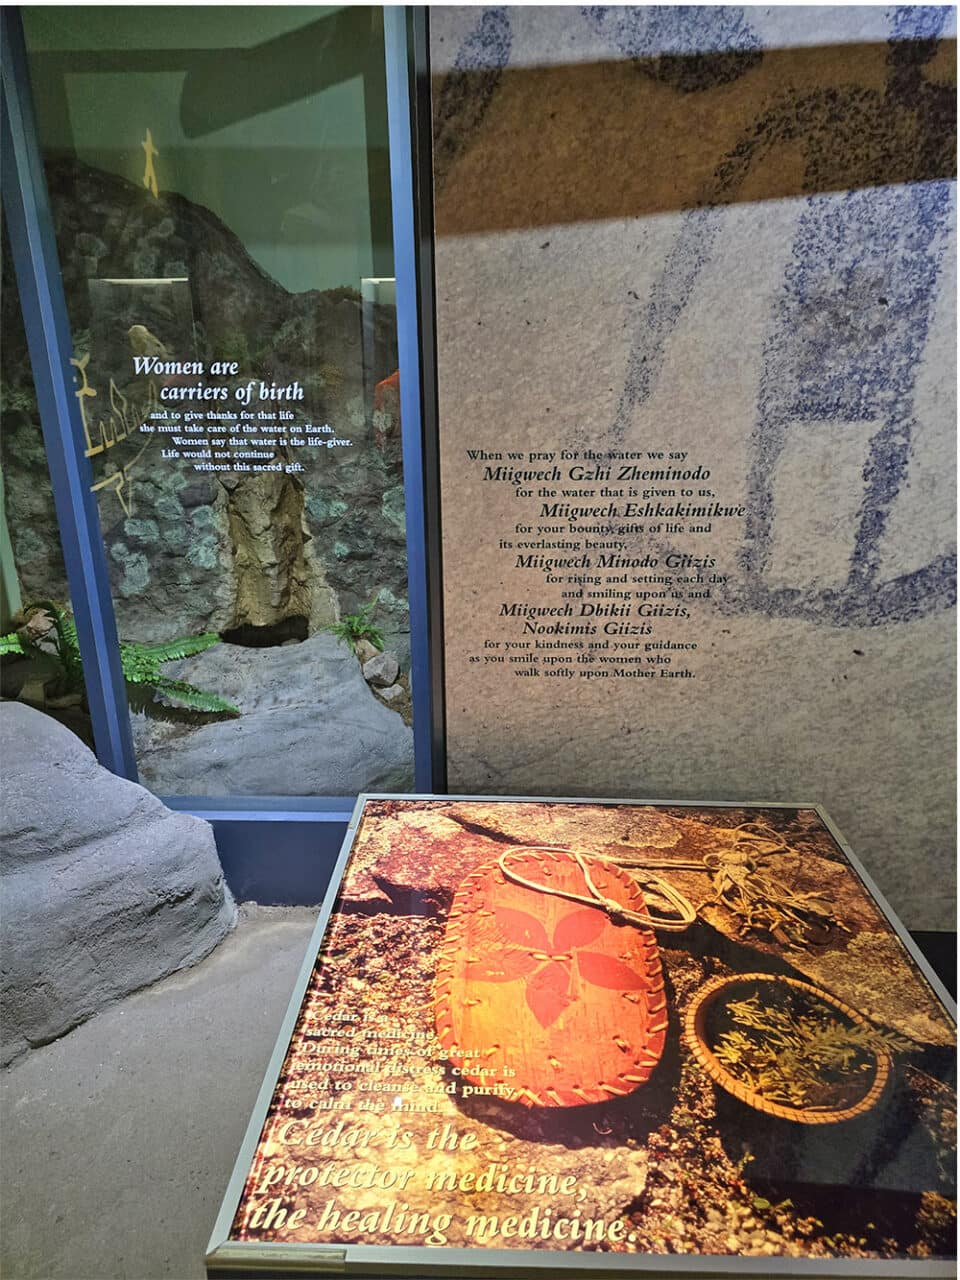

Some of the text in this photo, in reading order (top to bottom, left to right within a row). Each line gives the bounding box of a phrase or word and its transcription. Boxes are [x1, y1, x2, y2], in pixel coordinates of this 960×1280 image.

[133, 356, 239, 375] Women are
[160, 382, 304, 405] carriers of birth
[150, 410, 295, 422] and to give thanks for that life
[139, 423, 155, 433] she
[158, 425, 182, 433] must
[184, 423, 204, 433] take
[230, 423, 241, 433] of
[242, 423, 258, 433] the
[260, 425, 287, 433] water
[305, 423, 335, 433] Earth.
[172, 436, 353, 448] Women say that water is the life-giver.
[161, 449, 275, 458] Life would not continue
[466, 449, 502, 460] When
[529, 453, 556, 463] pray
[560, 449, 579, 460] for
[583, 449, 602, 460] the
[607, 451, 642, 460] water
[669, 453, 688, 463] say
[194, 462, 305, 474] without this sacred gift.
[483, 466, 711, 485] Miigwech Gzhi Zheminodo
[515, 487, 715, 500] for the water that is given to us,
[540, 503, 746, 522] Miigwech Eshkakimikwe
[515, 523, 533, 534] for
[537, 526, 565, 536] your
[617, 523, 644, 536] gifts
[649, 523, 663, 534] of
[665, 523, 684, 534] life
[689, 523, 712, 534] and
[499, 539, 513, 549] its
[517, 539, 581, 552] everlasting
[515, 554, 716, 572] Miigwech Minodo Giizis
[546, 574, 729, 587] for rising and setting each day
[561, 589, 583, 599] and
[587, 589, 631, 601] smiling
[635, 592, 666, 601] upon
[688, 589, 711, 599] and
[499, 603, 691, 621] Miigwech Dbikii Giizis,
[522, 622, 652, 635] Nookimis Giizis
[484, 639, 698, 652] for your kindness and your guidance
[469, 654, 671, 666] as you smile upon the women who
[514, 668, 696, 681] walk softly upon Mother Earth.
[334, 1081, 353, 1093] to
[359, 1080, 420, 1094] cleanse
[424, 1081, 457, 1094] and
[277, 1119, 479, 1151] Cedar is the
[259, 1166, 589, 1202] protector medicine,
[249, 1201, 639, 1246] the healing medicine.
